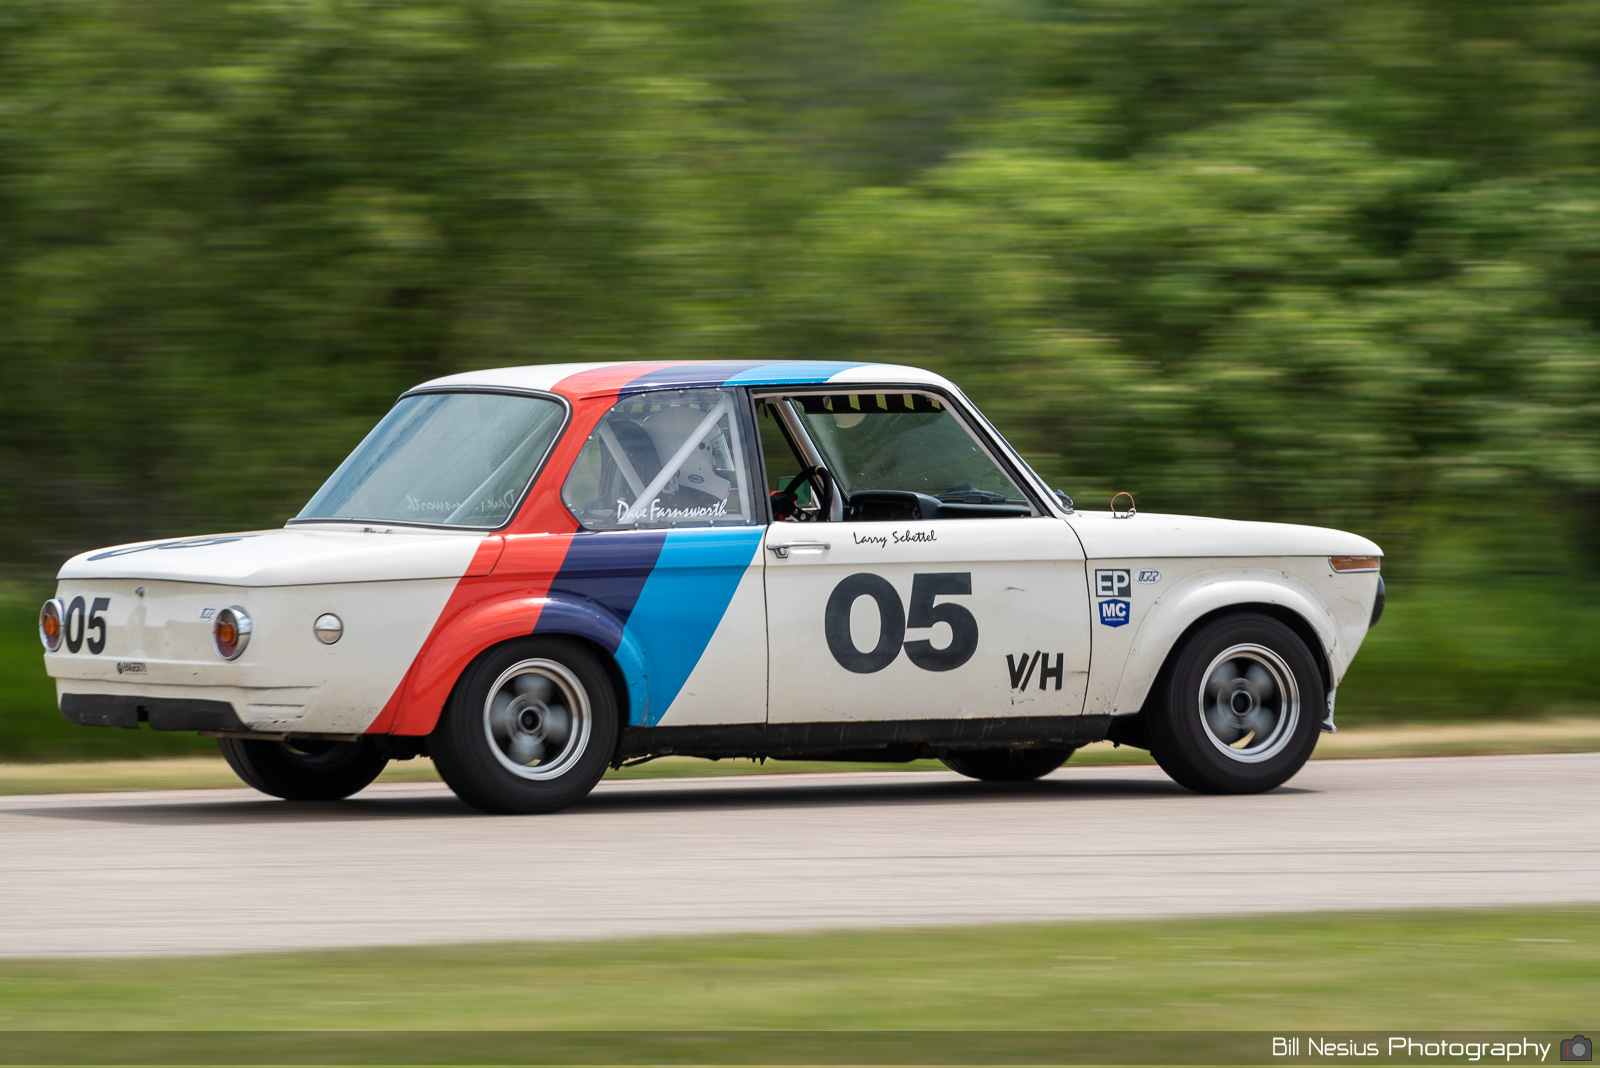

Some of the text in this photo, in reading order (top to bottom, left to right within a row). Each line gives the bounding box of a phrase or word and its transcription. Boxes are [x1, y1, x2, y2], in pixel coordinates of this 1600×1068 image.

[616, 499, 728, 521] Dave Farnsworth
[853, 529, 938, 549] Larry Schettel
[1096, 570, 1130, 597] EP
[825, 572, 979, 674] 05
[1102, 602, 1127, 618] MC
[65, 595, 112, 655] 05
[1006, 650, 1064, 692] V/H
